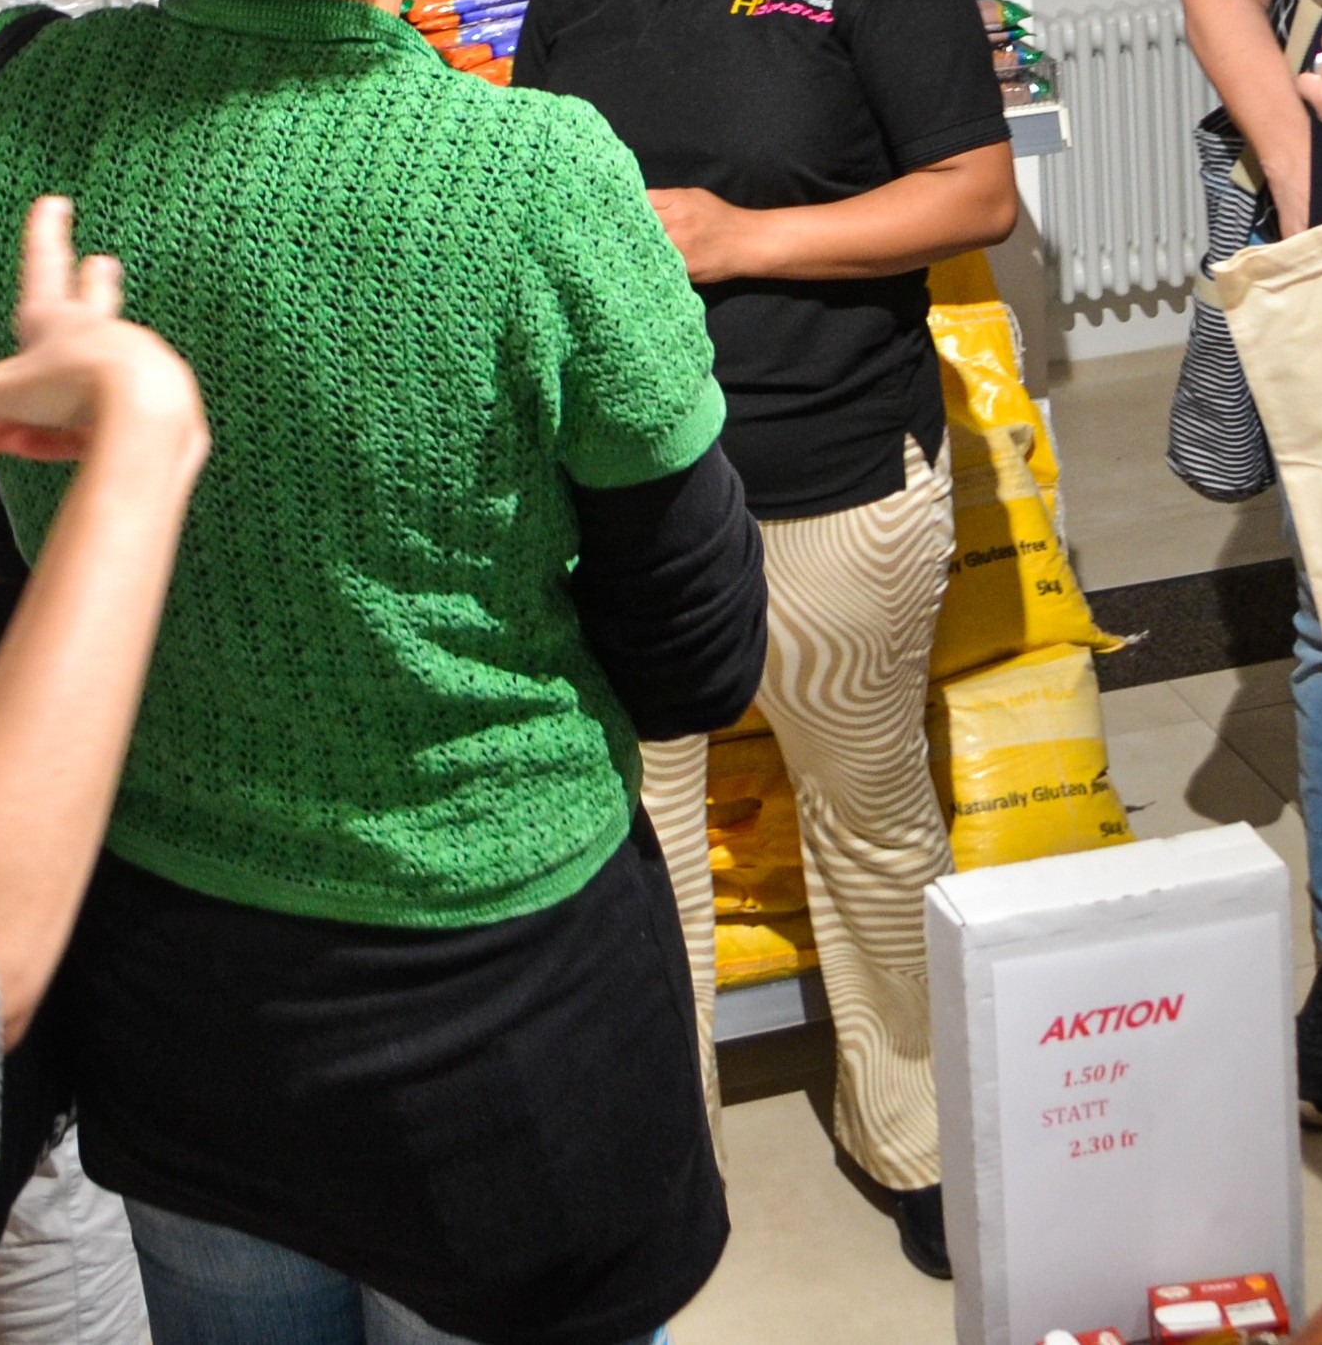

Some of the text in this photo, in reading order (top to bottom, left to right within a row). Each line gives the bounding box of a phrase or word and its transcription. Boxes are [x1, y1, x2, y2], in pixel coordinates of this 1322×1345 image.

[963, 545, 1018, 568] Gluten
[1020, 540, 1048, 556] free
[1036, 579, 1063, 596] 5kg
[952, 789, 1028, 817] Naturally
[1032, 780, 1087, 803] Gluten
[1039, 993, 1185, 1046] AKTION
[1063, 1060, 1130, 1088] 1.50 fr
[1041, 1099, 1109, 1128] STATT
[1069, 1129, 1138, 1158] 2.30 fr
